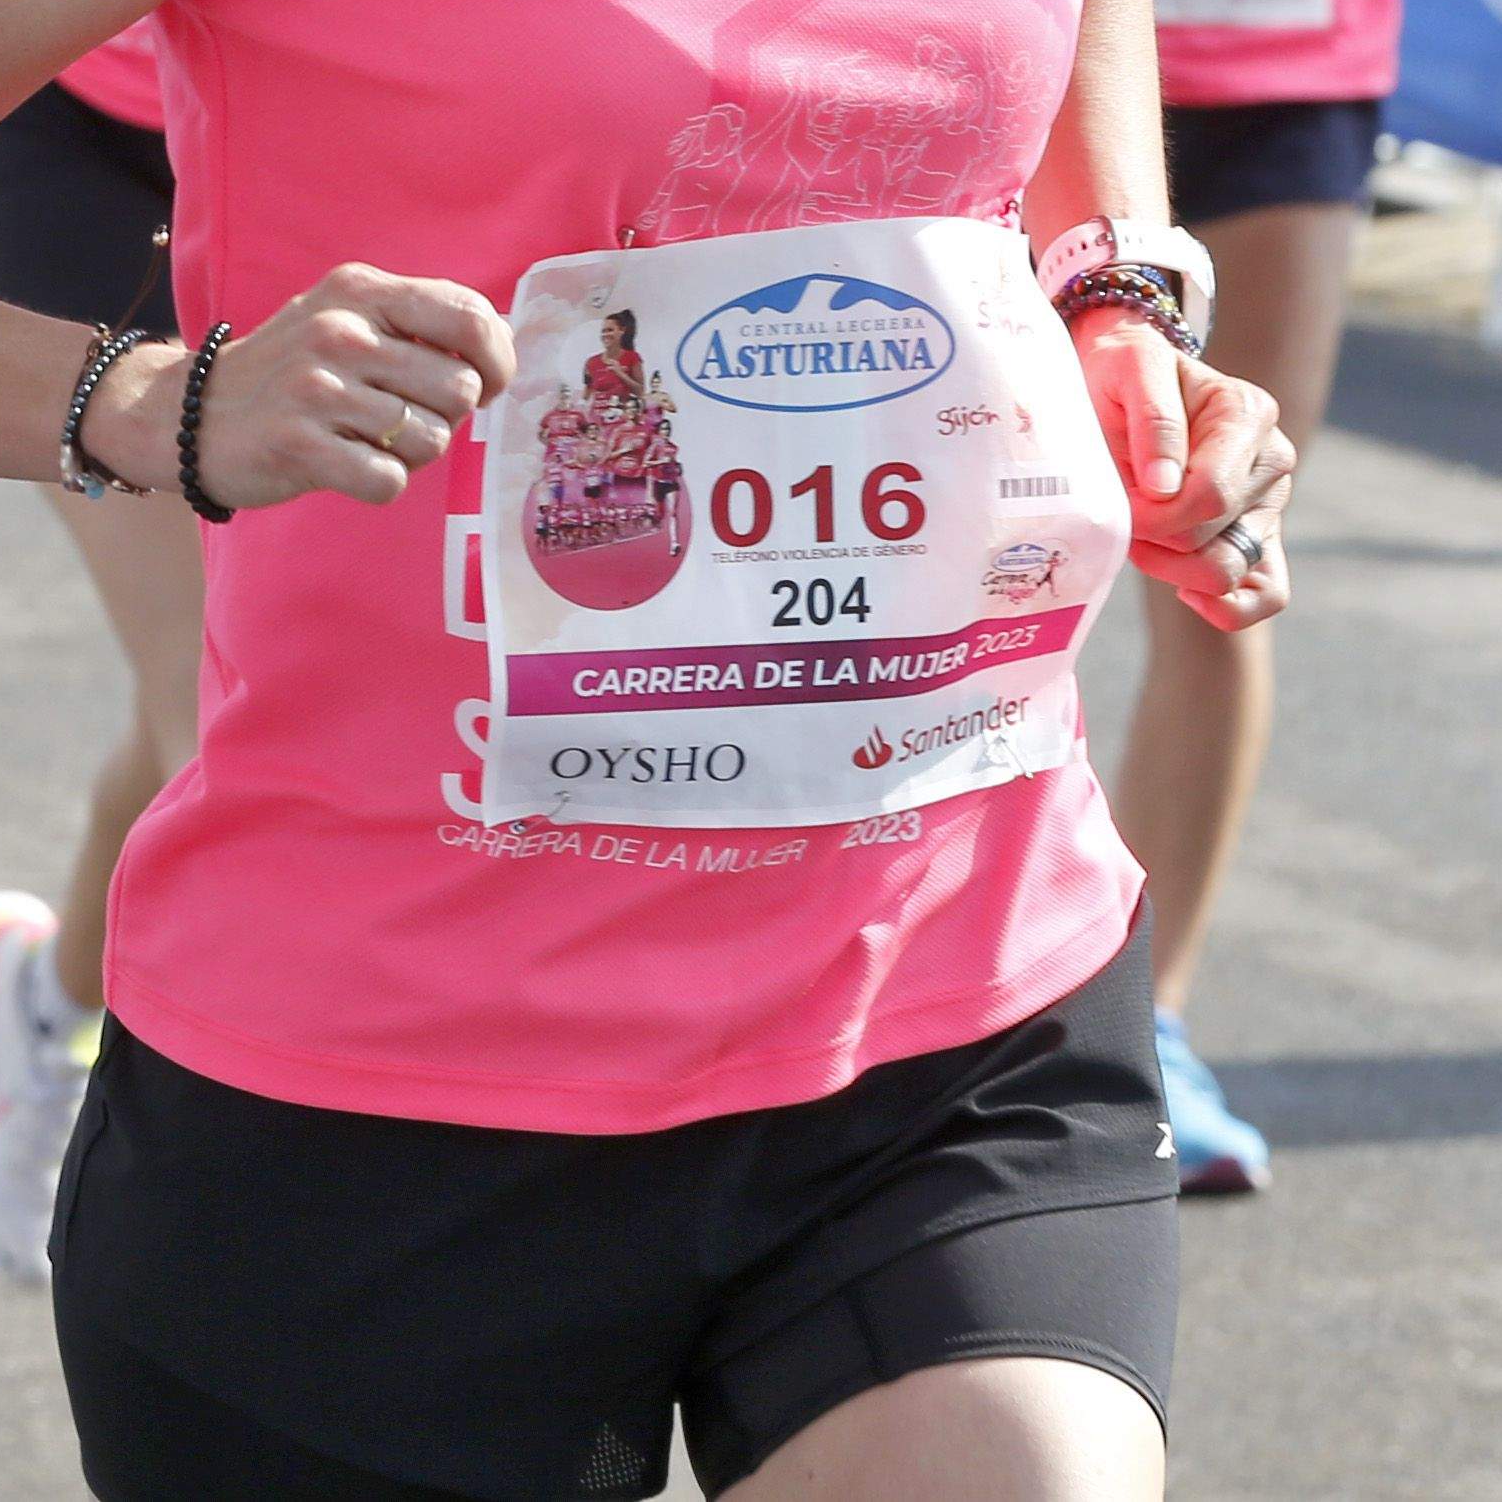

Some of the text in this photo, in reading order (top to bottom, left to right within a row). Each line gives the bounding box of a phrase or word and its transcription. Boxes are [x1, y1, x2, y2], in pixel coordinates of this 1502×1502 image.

[740, 317, 926, 338] CENTRAL LECHERA
[695, 329, 936, 380] ASTURIANA
[711, 461, 927, 548] 016
[711, 543, 928, 564] TELÉFONO VIOLENCIA DE GÉNERO
[771, 576, 872, 628] 204
[572, 624, 1042, 698] CARRERA DE LA MUJER 2023
[898, 695, 1031, 763] Santander
[549, 743, 746, 784] OYSHO
[436, 824, 582, 859] CARRERA
[589, 834, 644, 865] DE
[645, 841, 688, 871] LA
[840, 810, 923, 849] 2023
